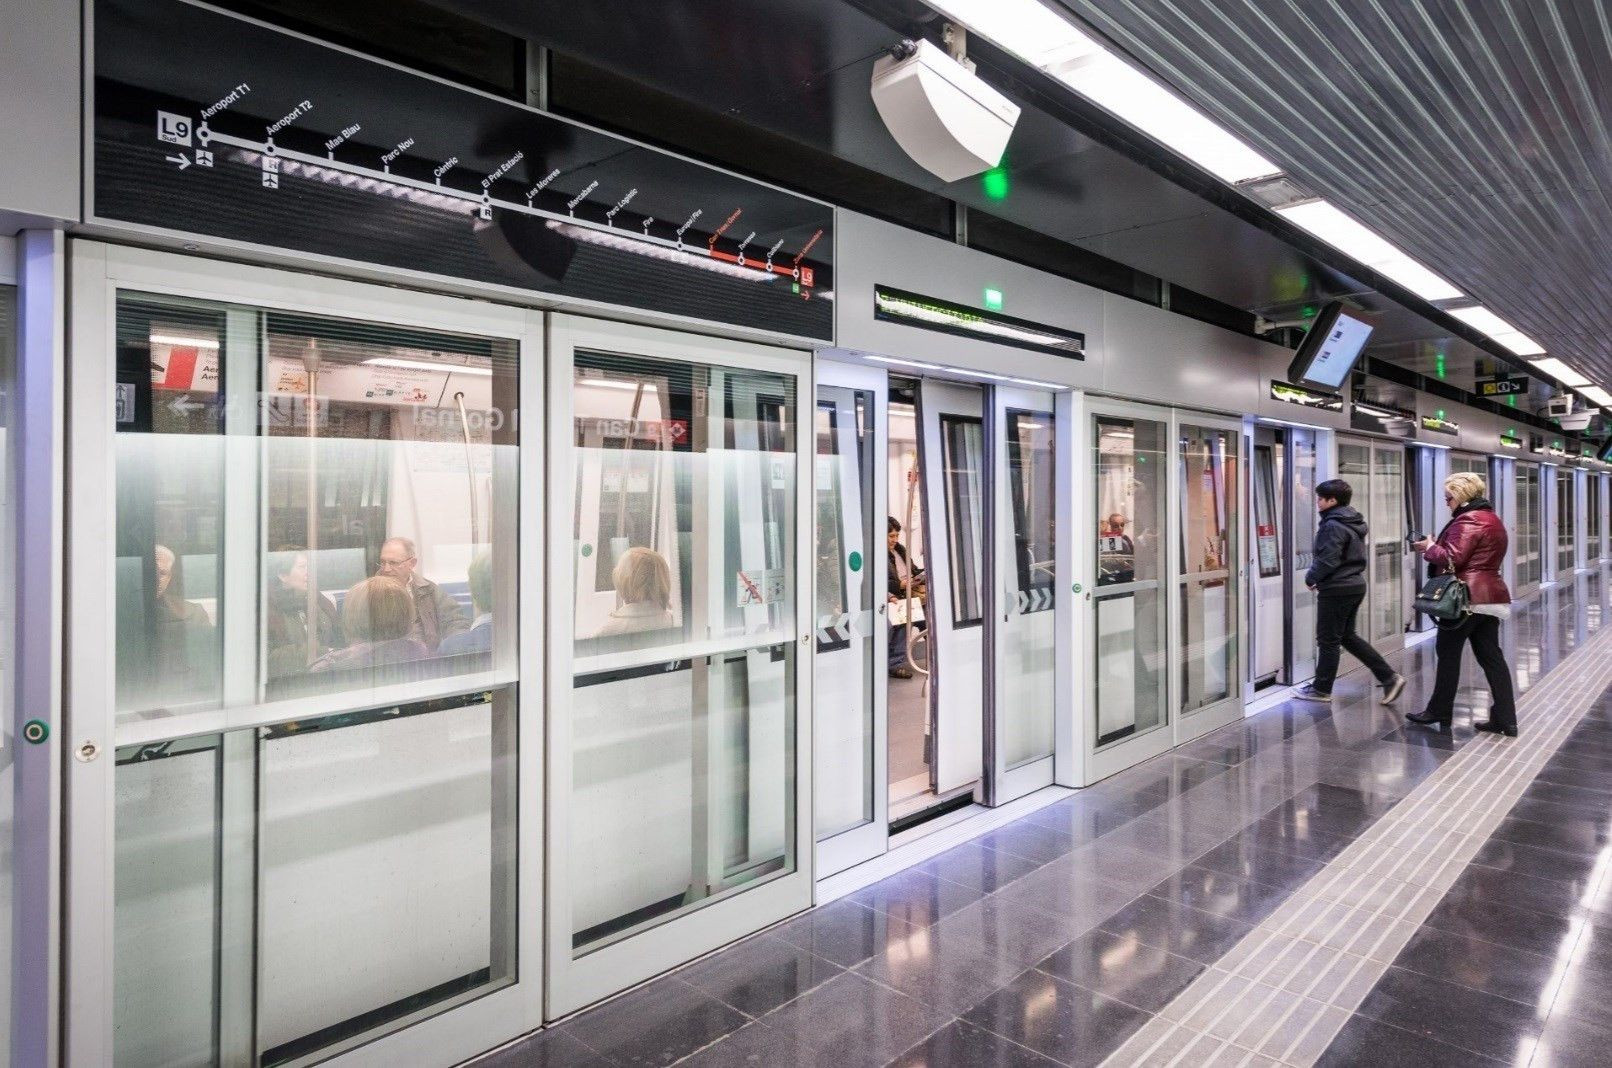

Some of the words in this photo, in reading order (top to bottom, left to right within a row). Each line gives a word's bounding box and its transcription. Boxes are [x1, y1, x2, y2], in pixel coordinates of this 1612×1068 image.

[201, 90, 240, 120] Aeroport
[236, 83, 251, 95] T1
[162, 118, 189, 138] L9
[267, 107, 302, 135] Aeroport
[299, 100, 313, 111] T2
[162, 134, 177, 143] Sud
[325, 135, 344, 150] Mas
[342, 123, 361, 139] Blau
[381, 149, 400, 164] Parc
[398, 137, 414, 151] Nou
[481, 179, 490, 188] El
[488, 169, 503, 182] Prat
[500, 151, 524, 172] Estació
[526, 187, 539, 199] Les
[484, 209, 491, 217] R
[606, 206, 620, 218] Parc
